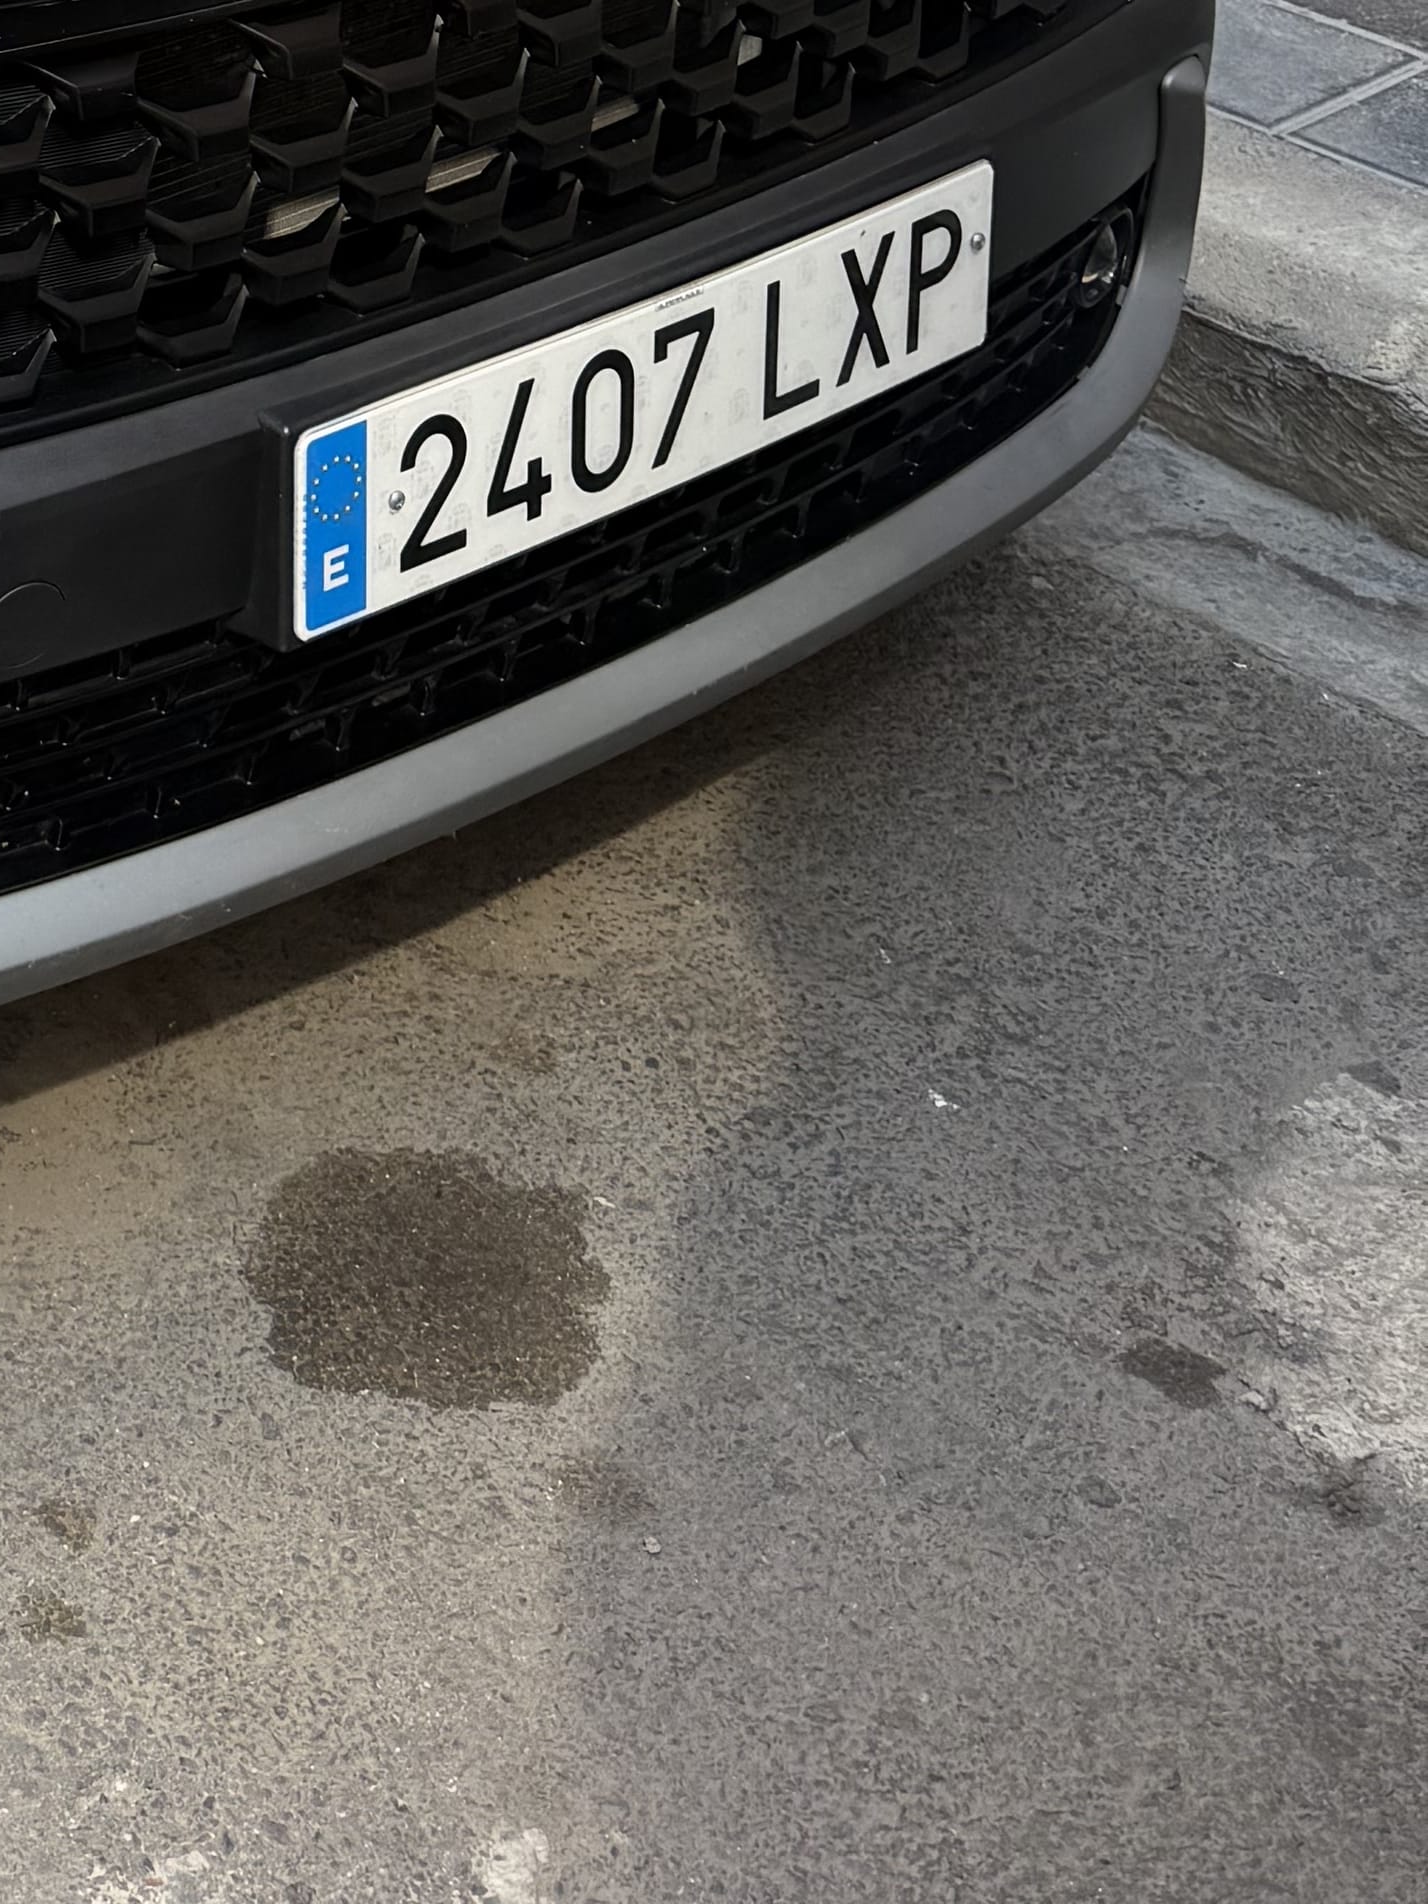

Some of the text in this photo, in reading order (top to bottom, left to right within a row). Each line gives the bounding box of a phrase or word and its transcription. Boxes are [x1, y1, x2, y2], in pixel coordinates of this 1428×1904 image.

[323, 544, 349, 592] E
[399, 307, 715, 574] 2407
[762, 208, 963, 422] LXP
